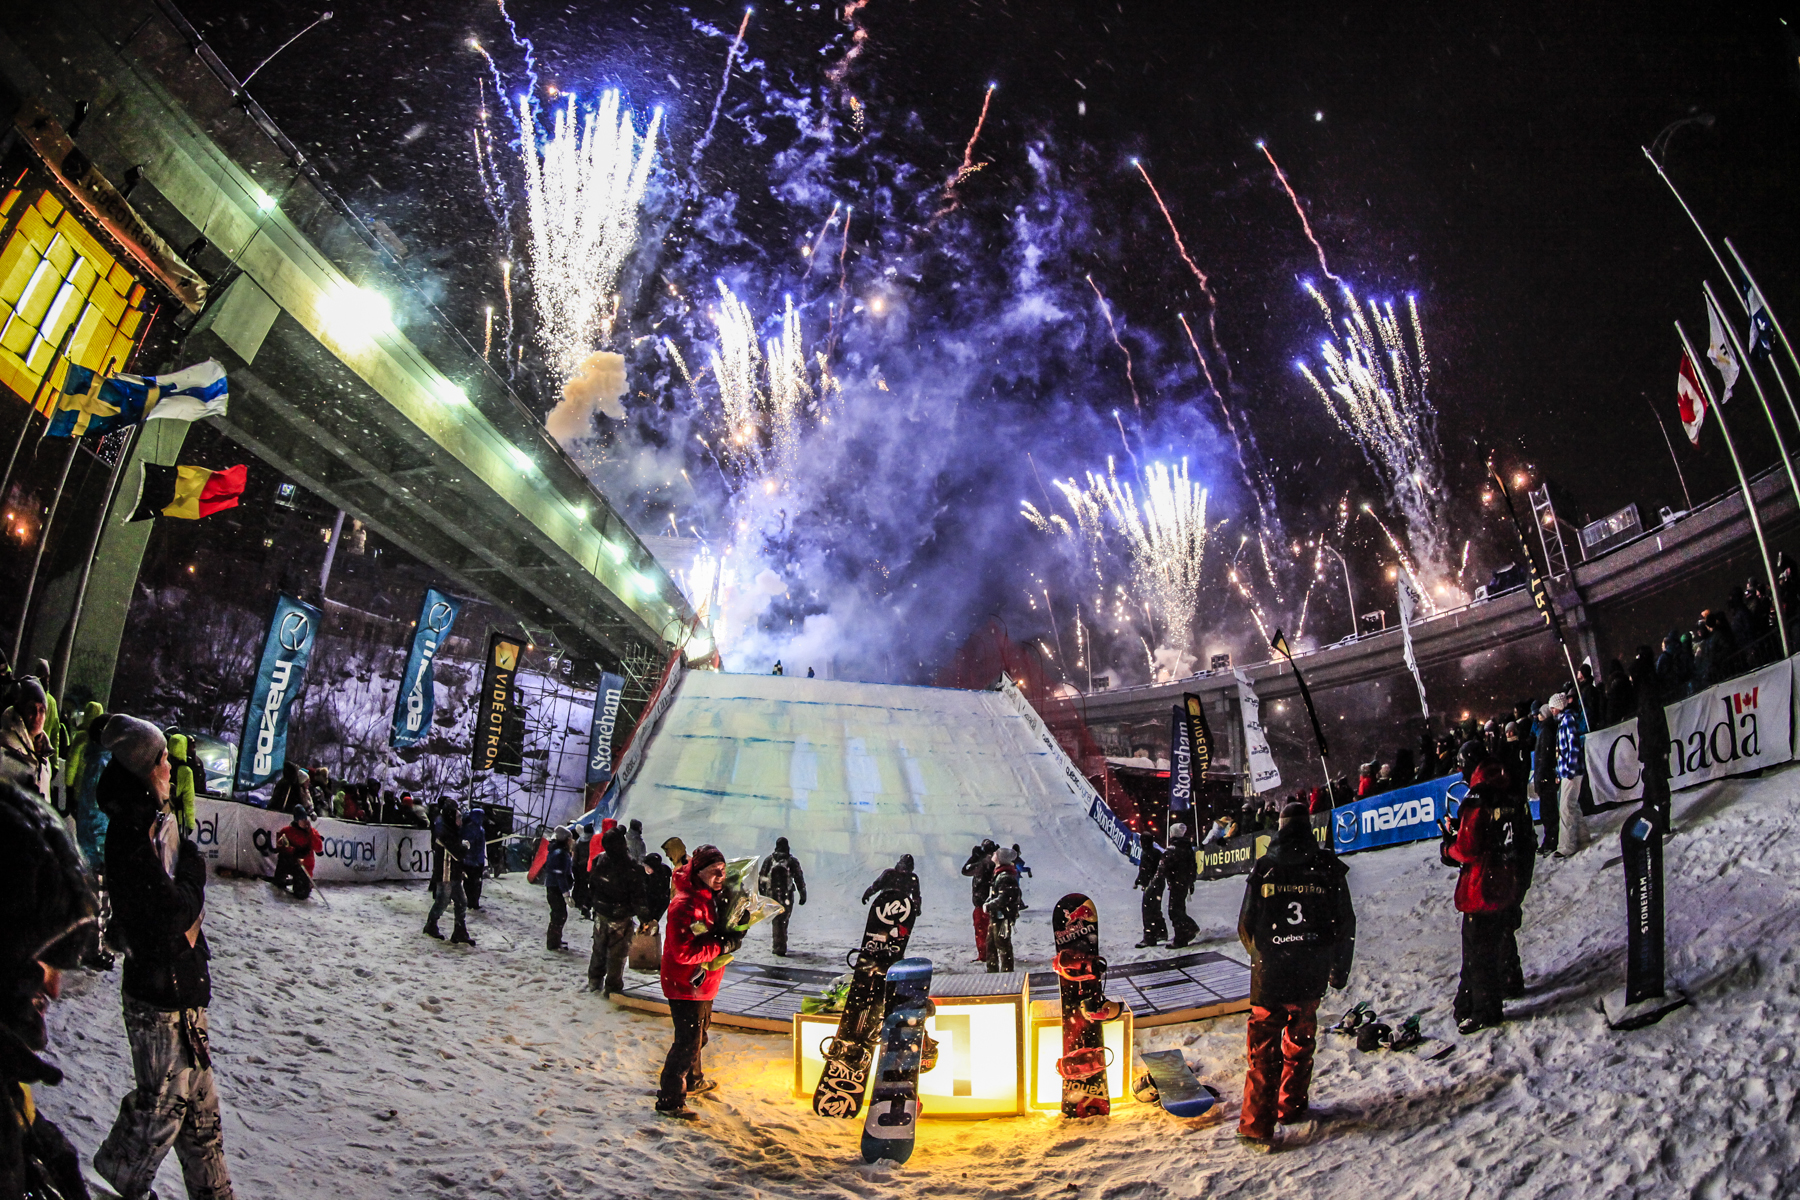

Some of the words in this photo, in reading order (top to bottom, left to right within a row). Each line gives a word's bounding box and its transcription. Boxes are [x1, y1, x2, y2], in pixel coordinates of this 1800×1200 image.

[252, 659, 293, 776] mazda
[484, 673, 508, 769] VIDÉOTRON
[591, 688, 622, 772] Stoneham
[1606, 694, 1761, 790] Cnada
[1172, 721, 1191, 799] Stoneham
[1094, 801, 1126, 850] Stoneham
[1361, 796, 1435, 834] mazda
[397, 837, 436, 873] Can
[1204, 846, 1250, 868] VIDÉOTRON
[1286, 901, 1303, 925] 3
[1639, 876, 1649, 934] STONEHAM
[1272, 934, 1304, 945] Québec
[934, 1013, 972, 1097] 1
